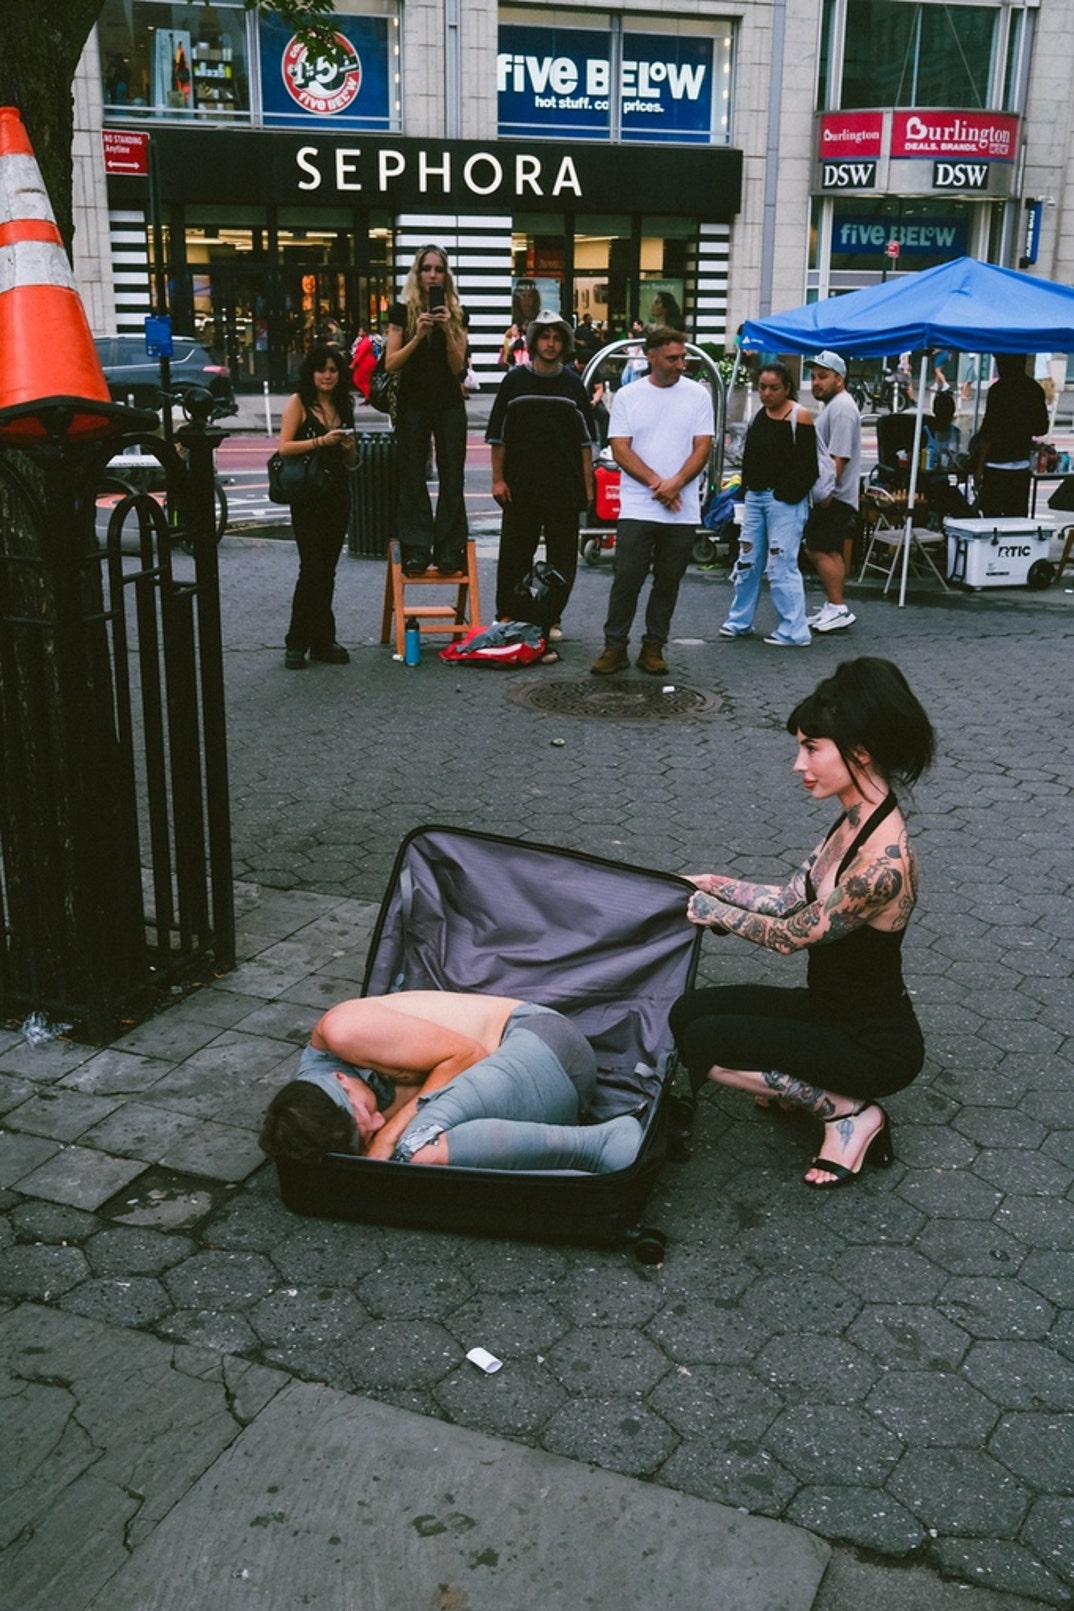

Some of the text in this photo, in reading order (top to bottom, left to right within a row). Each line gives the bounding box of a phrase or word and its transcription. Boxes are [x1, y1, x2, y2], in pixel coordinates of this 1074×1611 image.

[497, 53, 706, 100] five BELOW
[535, 96, 557, 109] hot
[558, 96, 593, 110] stuff.
[623, 101, 665, 115] prices.
[823, 129, 880, 144] Burlington
[906, 116, 1010, 149] Burlington
[296, 146, 583, 197] SEPHORA
[823, 163, 874, 187] DSW
[935, 163, 987, 187] DSW
[840, 223, 956, 247] five BELOW
[998, 545, 1032, 558] RTIC
